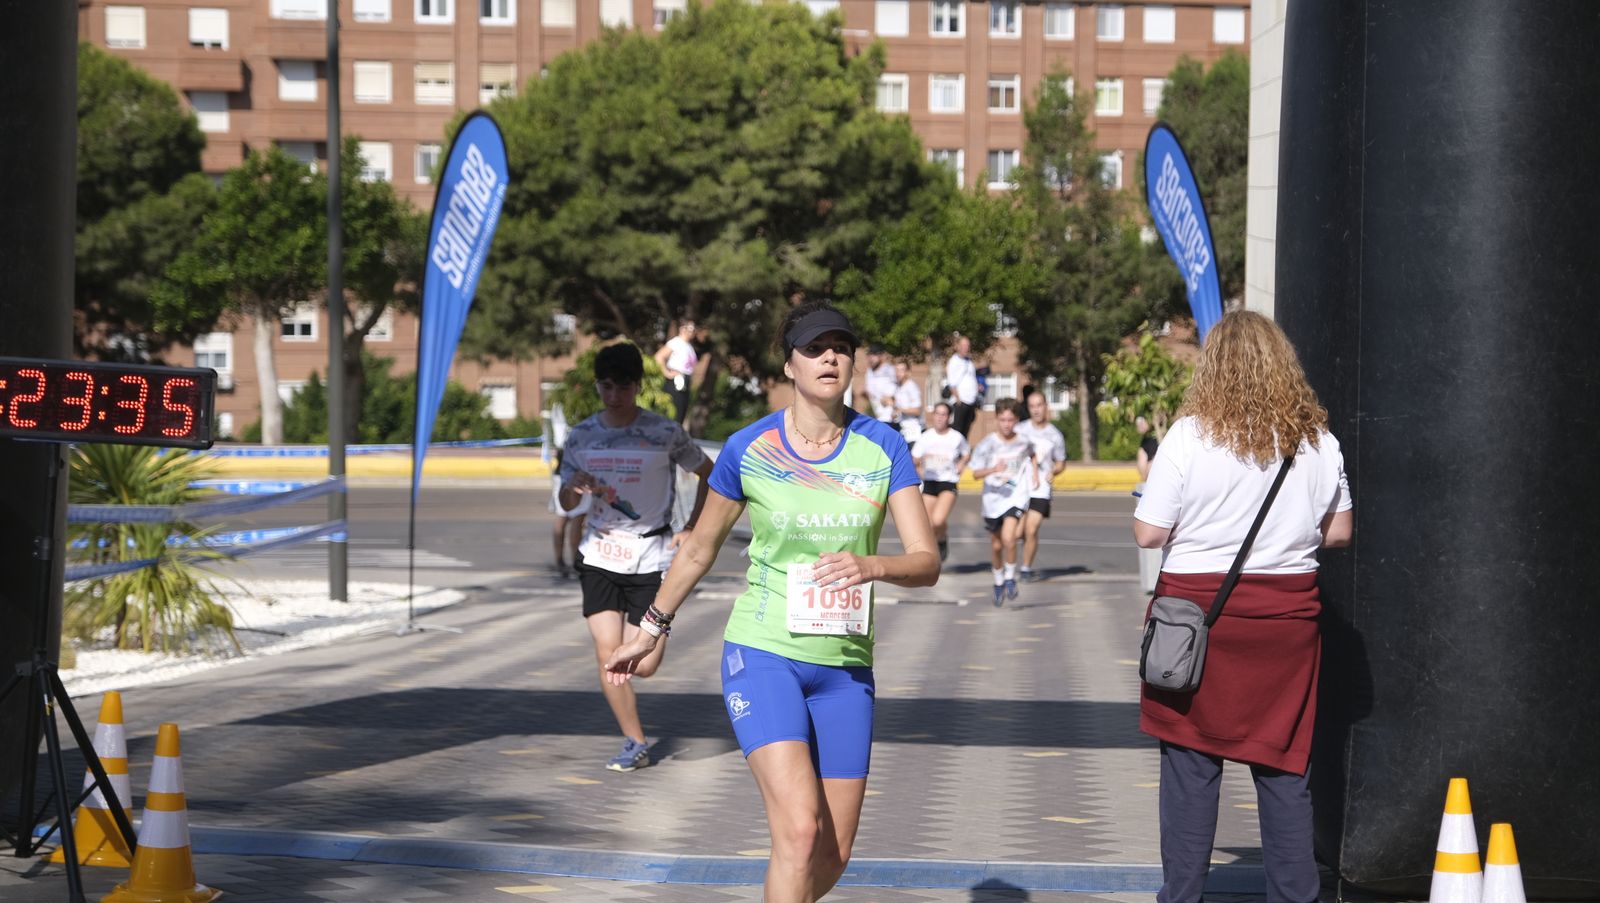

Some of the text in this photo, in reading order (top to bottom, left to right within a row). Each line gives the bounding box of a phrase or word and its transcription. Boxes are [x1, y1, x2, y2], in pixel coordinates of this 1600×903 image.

[795, 512, 873, 528] SAKATA
[787, 532, 827, 542] PASSION
[829, 534, 837, 542] in
[595, 540, 633, 560] 1038
[802, 586, 863, 610] 1096
